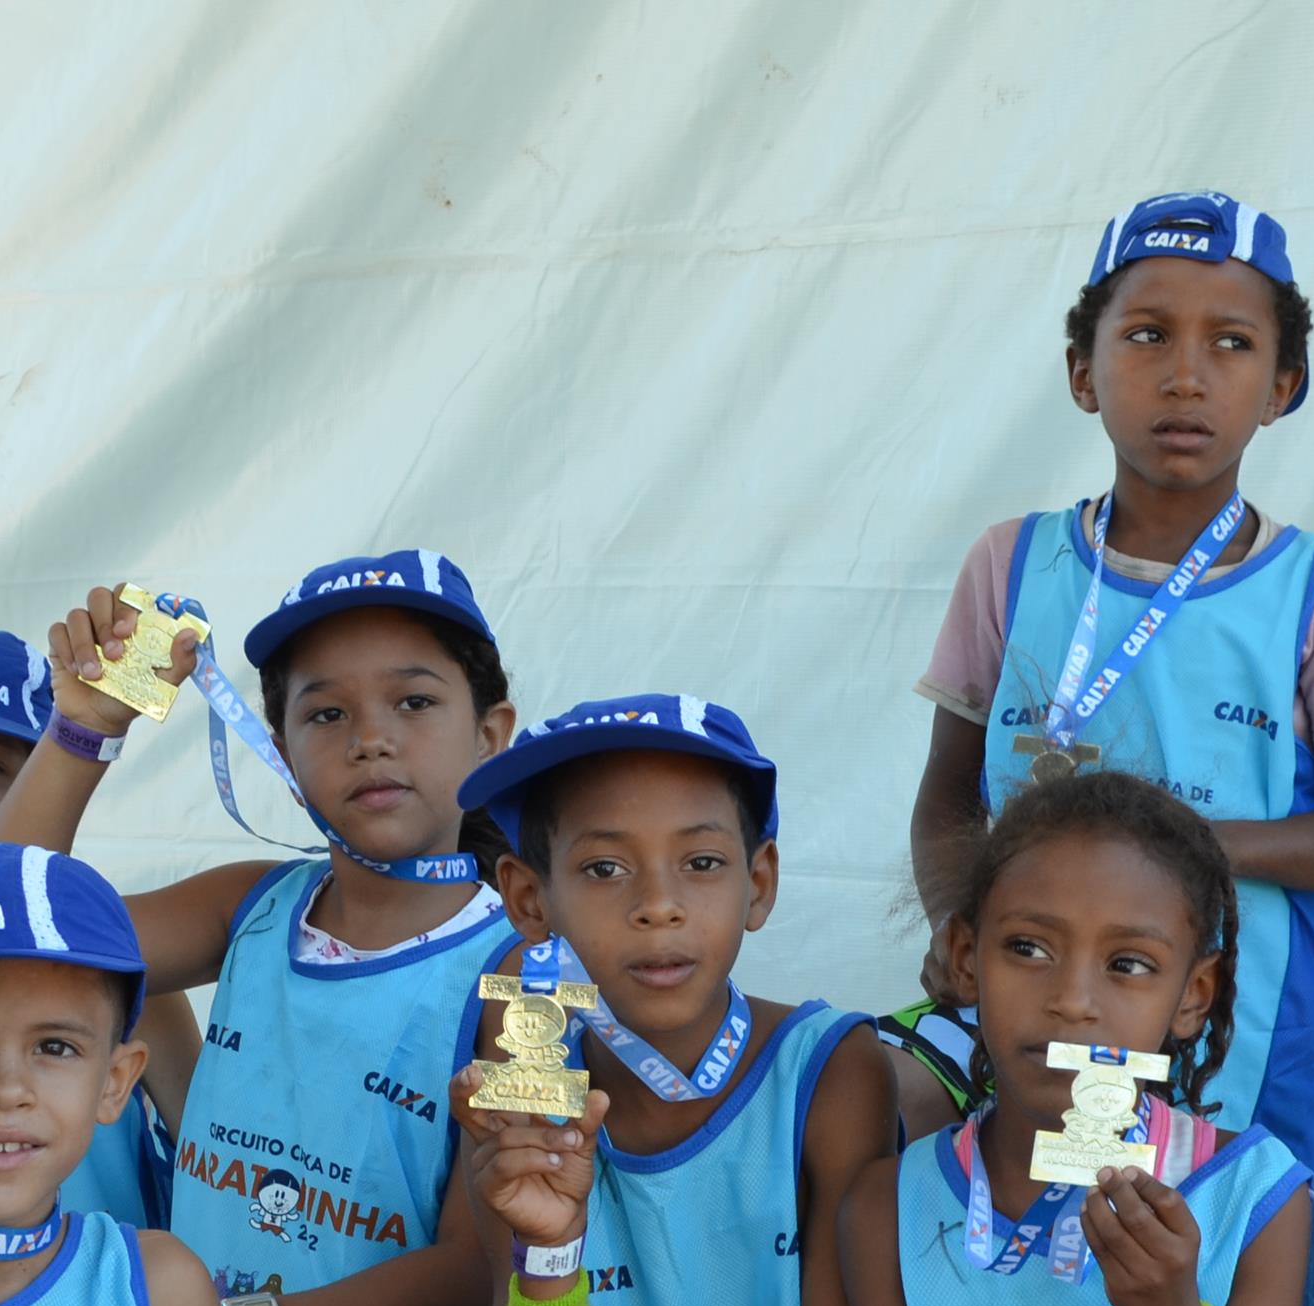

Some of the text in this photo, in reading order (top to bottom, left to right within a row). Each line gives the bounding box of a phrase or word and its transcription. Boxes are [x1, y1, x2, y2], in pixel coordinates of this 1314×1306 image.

[1144, 232, 1210, 252] CAIXA
[1212, 495, 1245, 542] CAIXA
[317, 570, 406, 594] CAIXA
[1168, 549, 1210, 597] CAIXA
[1123, 607, 1166, 657] CAIXA
[1076, 667, 1121, 717] CAIXA
[1190, 786, 1214, 804] DE
[697, 1015, 747, 1090] CAIXA
[364, 1071, 437, 1123] CAIXA
[328, 1163, 353, 1185] DE
[993, 1223, 1043, 1275] AIXA
[587, 1264, 634, 1293] IXA
